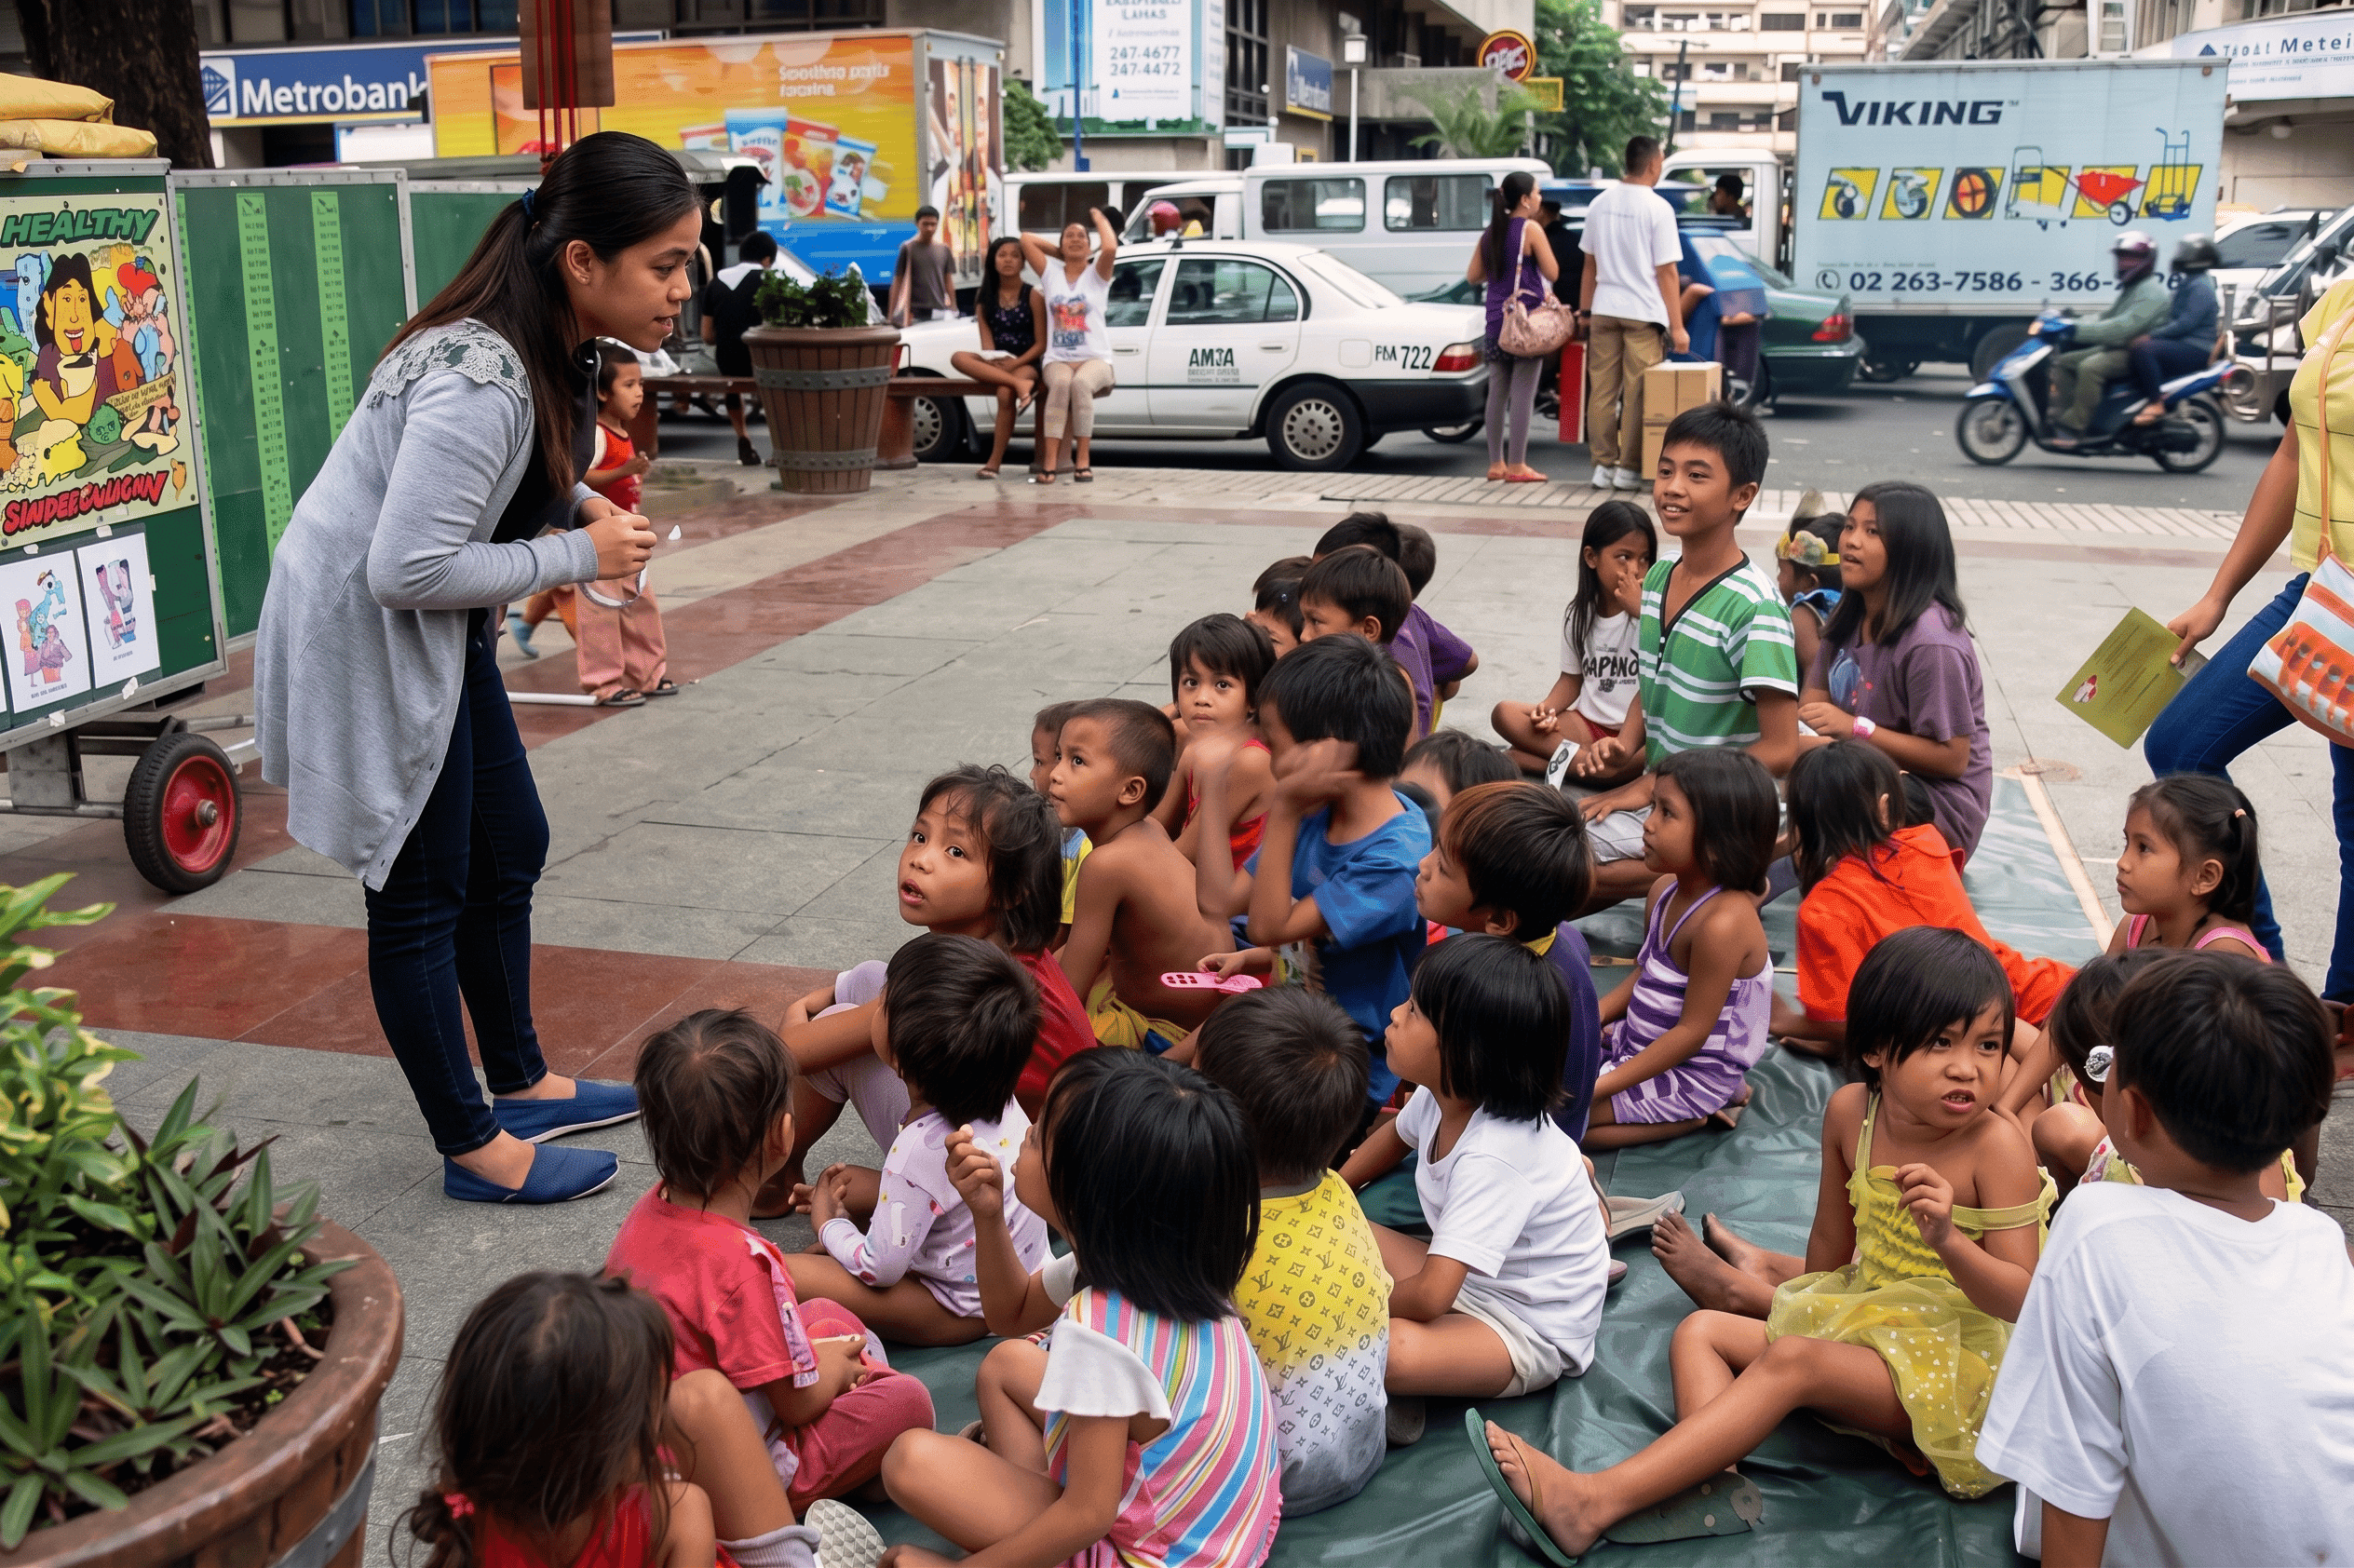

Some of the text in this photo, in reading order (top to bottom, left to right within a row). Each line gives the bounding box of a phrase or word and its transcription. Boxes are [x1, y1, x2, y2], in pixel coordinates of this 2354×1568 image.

[1821, 91, 2004, 126] VIKING
[0, 208, 160, 248] HEALTHY
[1849, 271, 1883, 291] 02
[1890, 271, 2023, 291] 263-7586
[1400, 345, 1432, 370] 722
